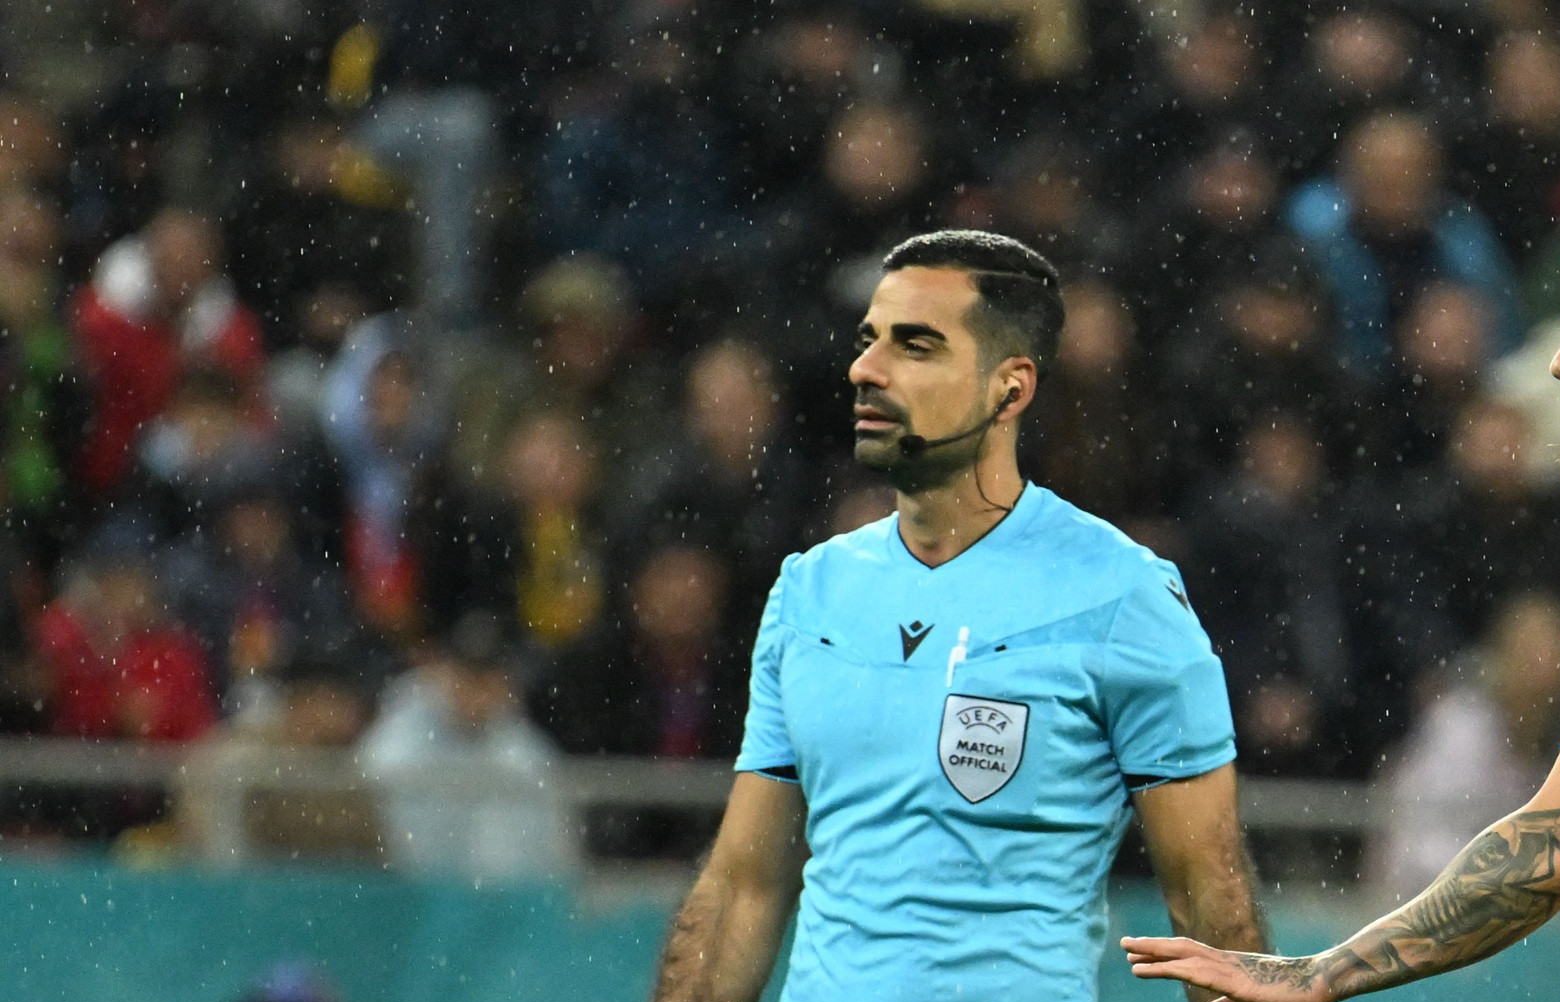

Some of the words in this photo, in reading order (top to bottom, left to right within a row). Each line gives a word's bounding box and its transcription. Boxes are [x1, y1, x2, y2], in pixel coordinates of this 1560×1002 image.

[958, 709, 1007, 732] UEFA
[956, 739, 1005, 756] MATCH
[949, 754, 1007, 774] OFFICIAL
